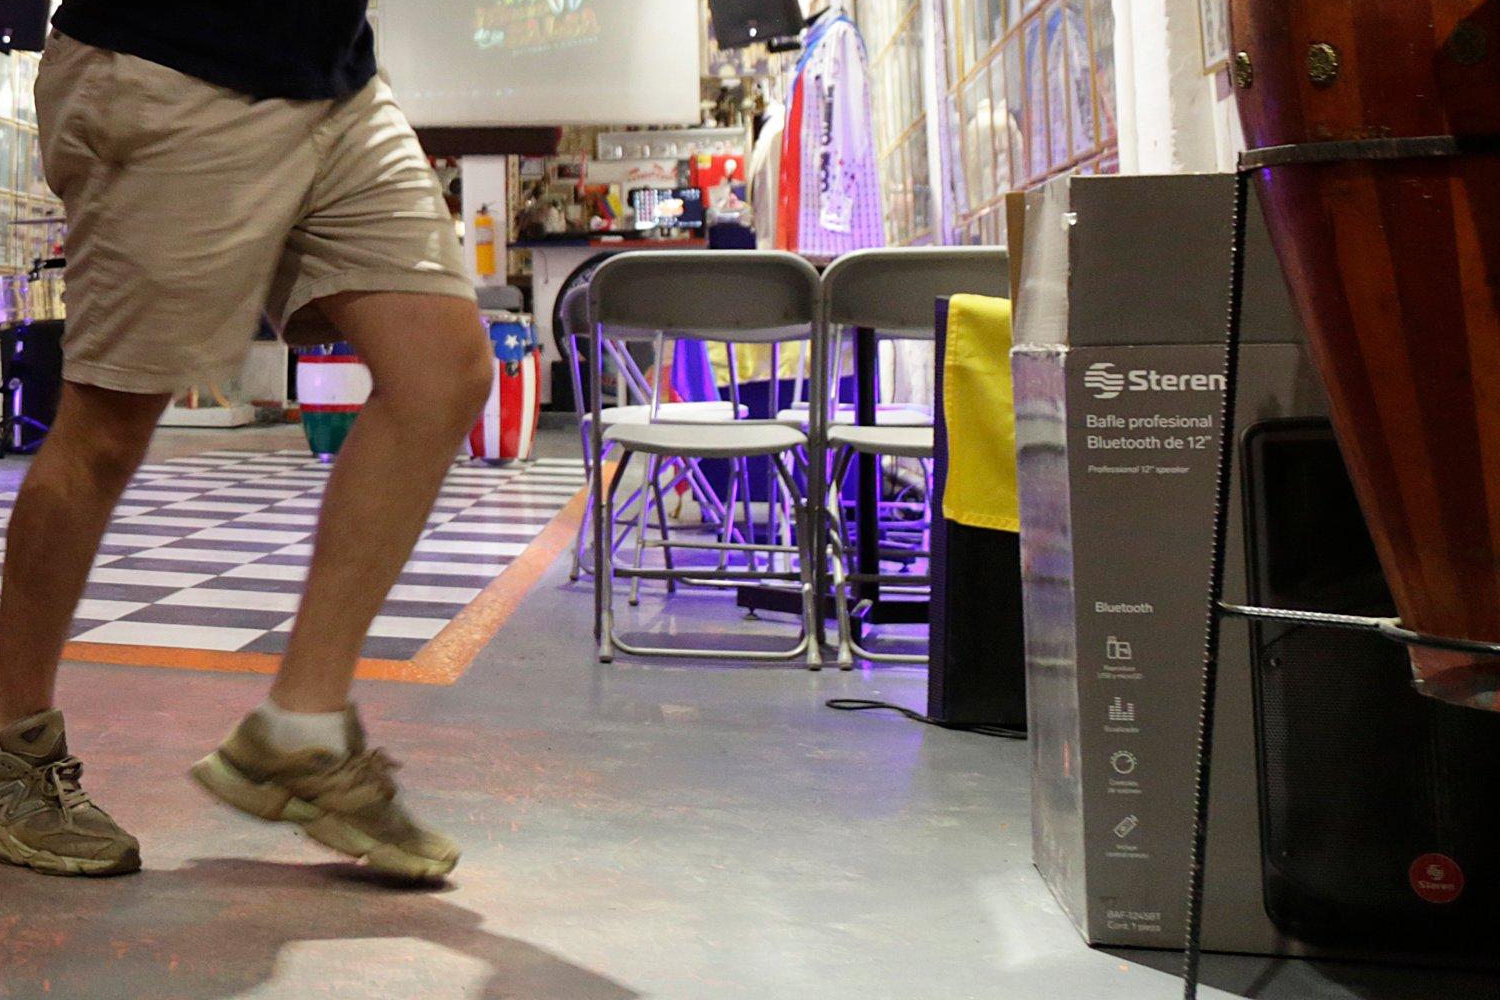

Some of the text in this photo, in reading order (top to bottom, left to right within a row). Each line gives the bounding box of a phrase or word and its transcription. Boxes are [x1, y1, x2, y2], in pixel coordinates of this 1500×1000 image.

[1128, 369, 1226, 392] Steren
[1086, 414, 1213, 430] Bafle profesional
[1087, 435, 1161, 450] Bluetooth
[1164, 436, 1184, 449] de
[1095, 601, 1154, 613] Bluetooth
